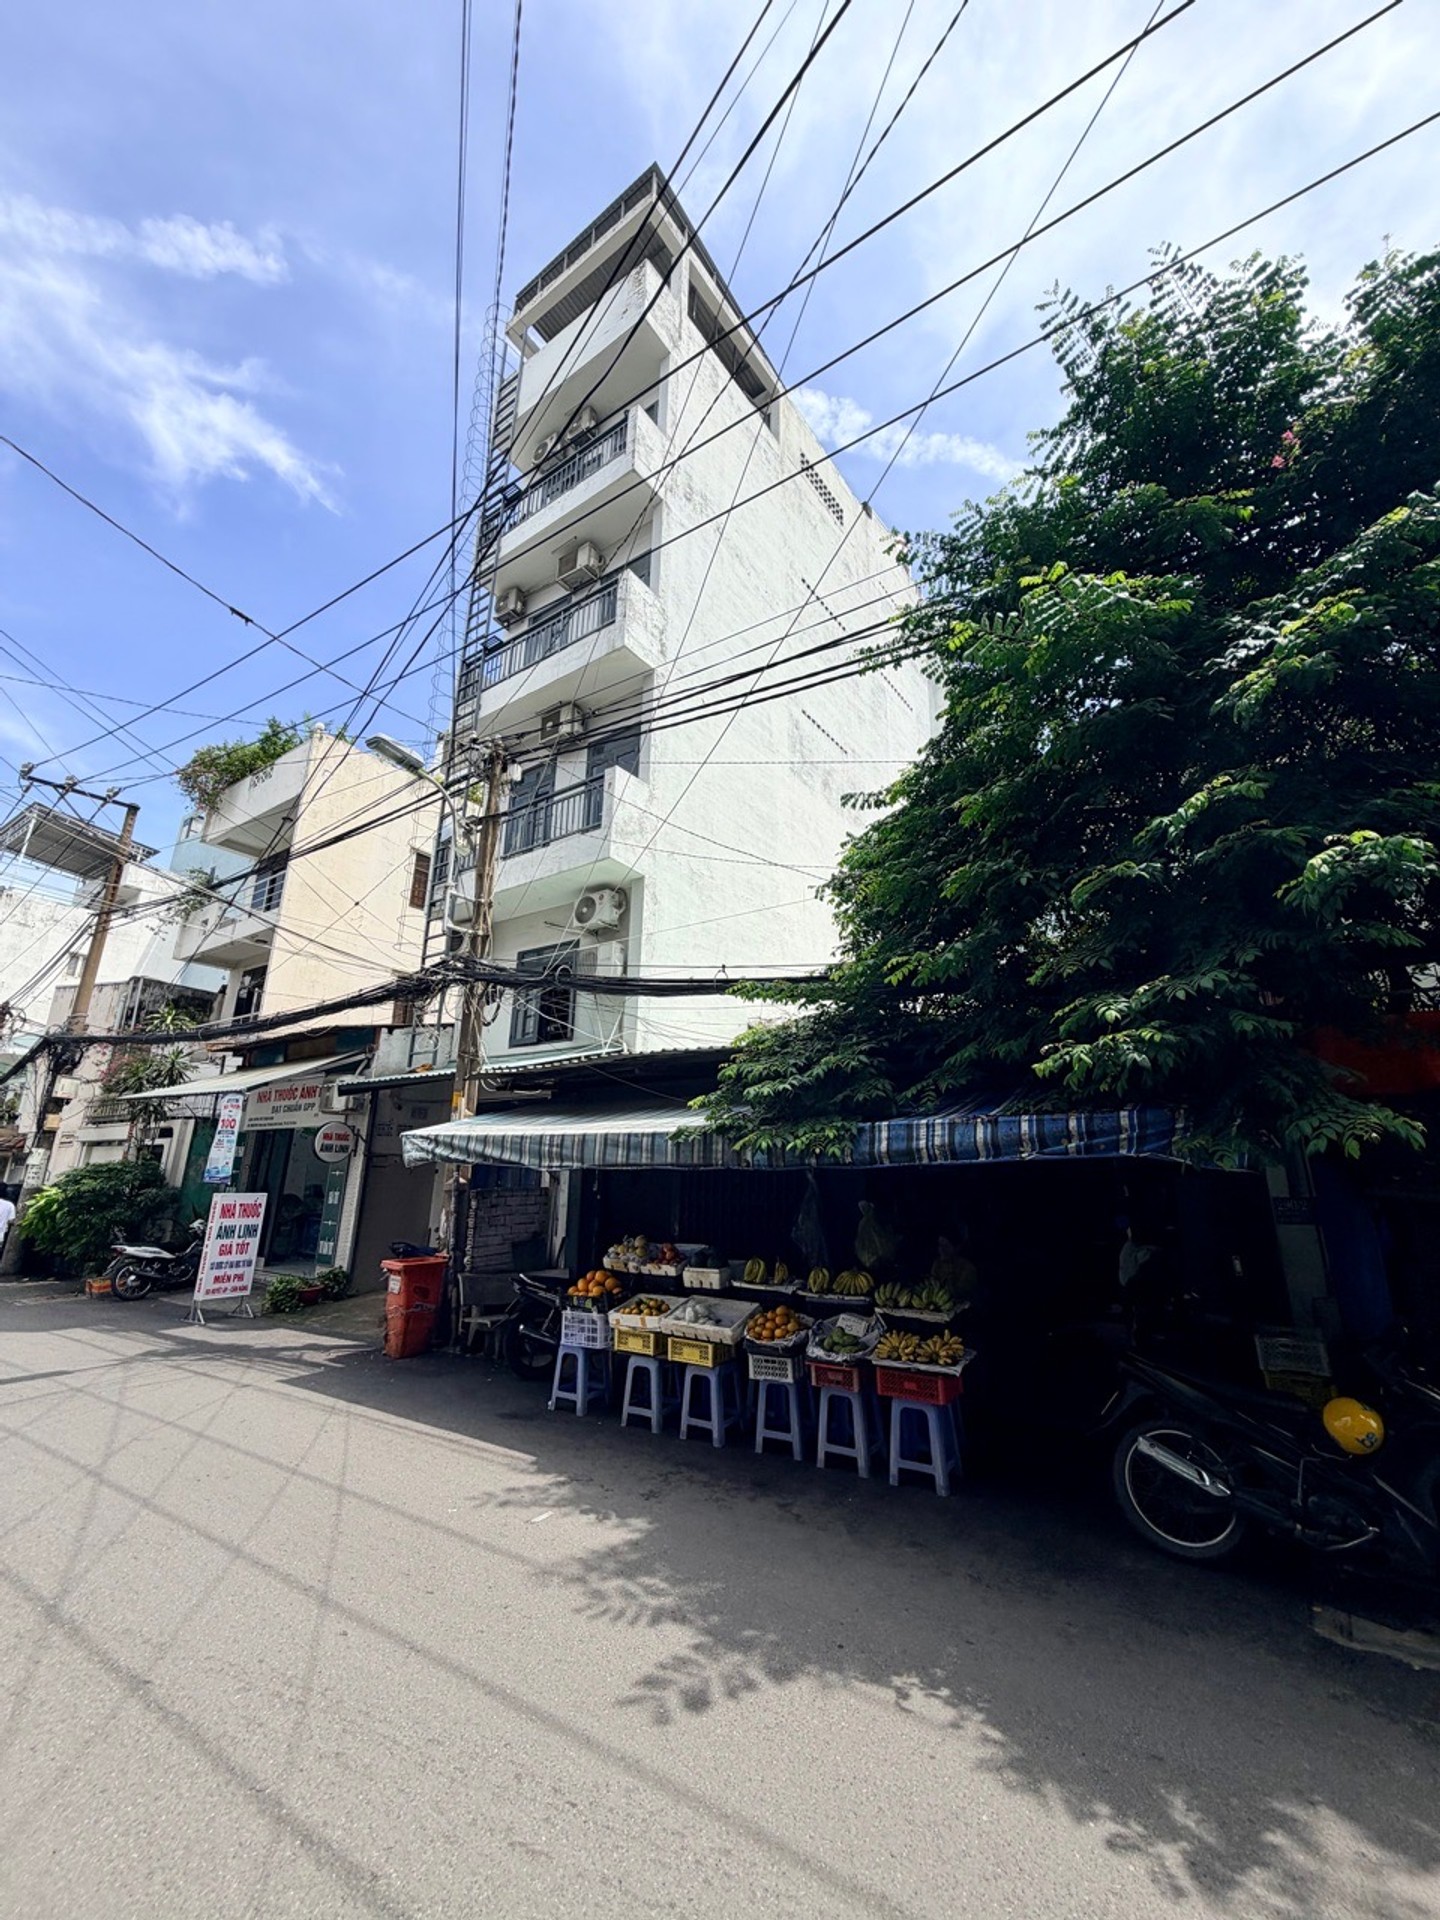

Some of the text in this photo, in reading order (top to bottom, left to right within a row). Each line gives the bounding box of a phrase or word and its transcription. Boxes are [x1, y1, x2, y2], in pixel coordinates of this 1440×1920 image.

[257, 1088, 272, 1103] NHÀ
[274, 1083, 298, 1102] THUỐC
[303, 1103, 316, 1112] GPP
[323, 1131, 350, 1141] NHÀ THUỐC
[334, 1144, 350, 1153] LINH
[219, 1197, 262, 1219] NHÀ THUỐC
[238, 1224, 259, 1239] LINH
[218, 1240, 250, 1256] GIÁ TỐT
[232, 1271, 245, 1282] PHÍ
